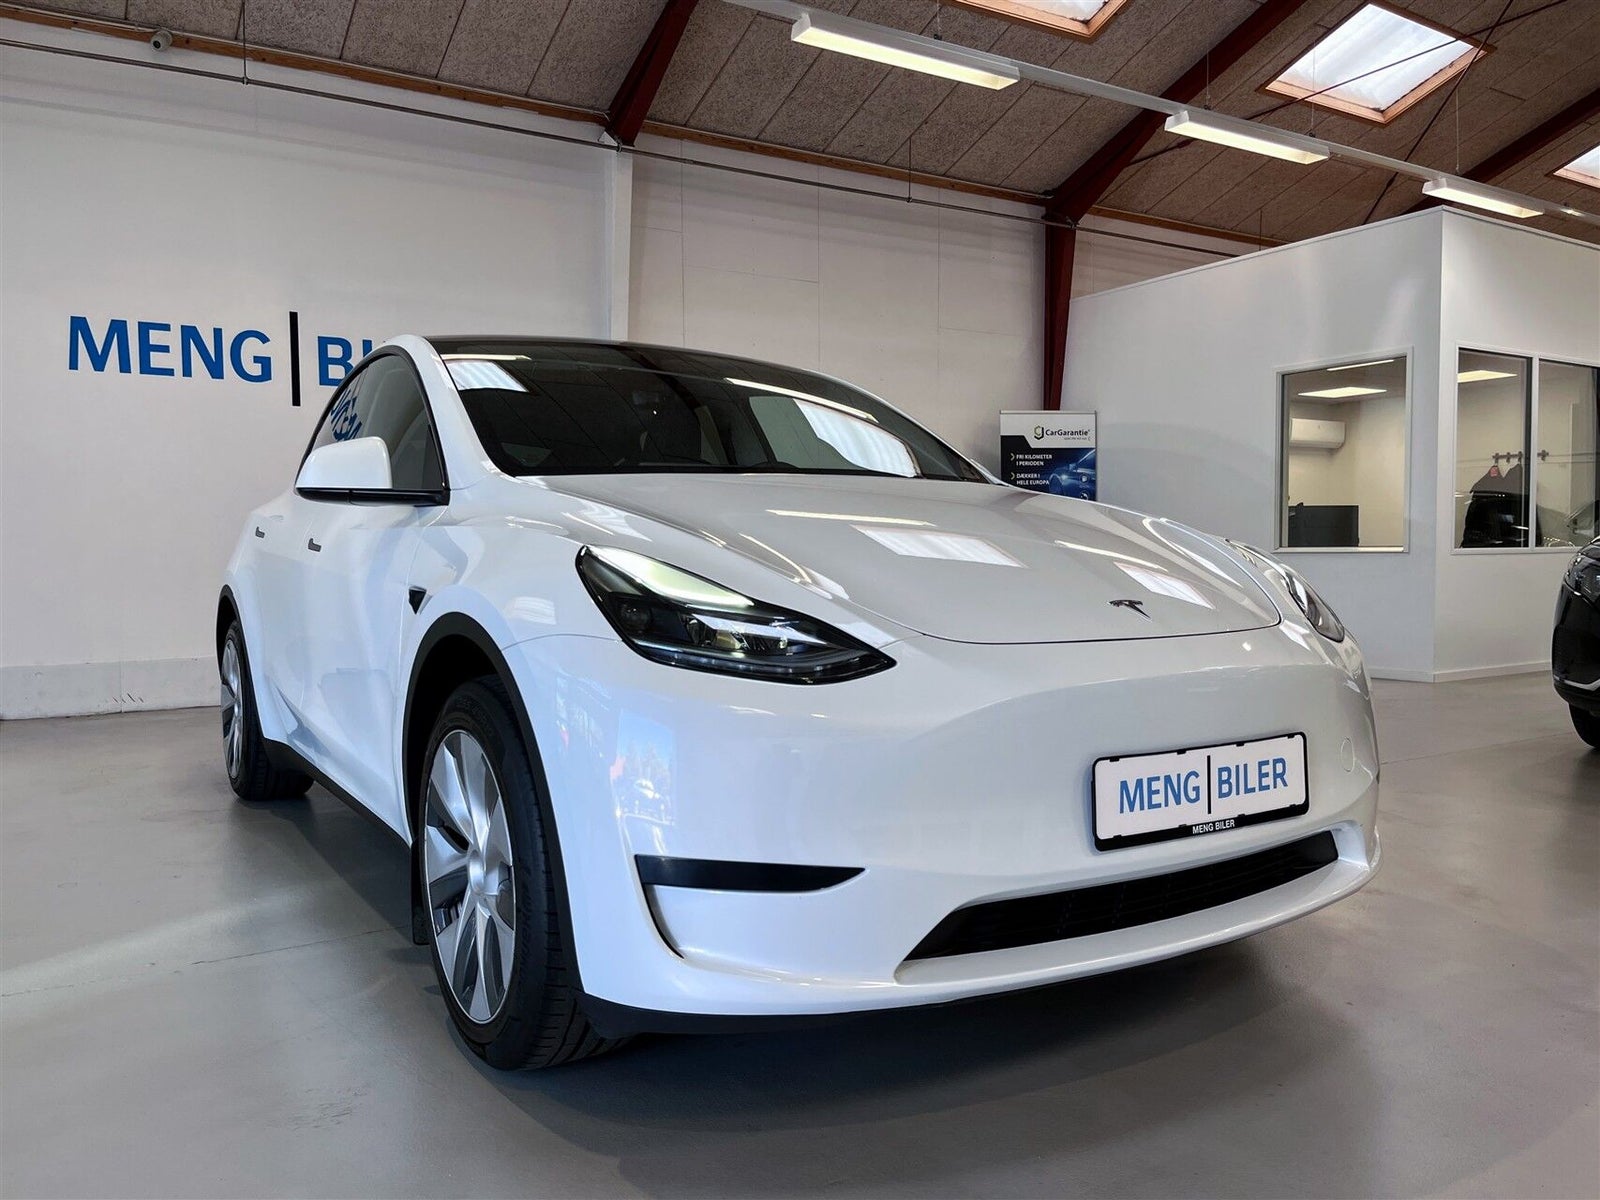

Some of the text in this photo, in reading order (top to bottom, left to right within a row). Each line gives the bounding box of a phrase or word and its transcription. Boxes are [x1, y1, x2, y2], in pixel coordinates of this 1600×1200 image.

[69, 315, 272, 383] MENG
[1119, 757, 1289, 814] MENG BILER
[1192, 819, 1235, 834] MENG BILER
